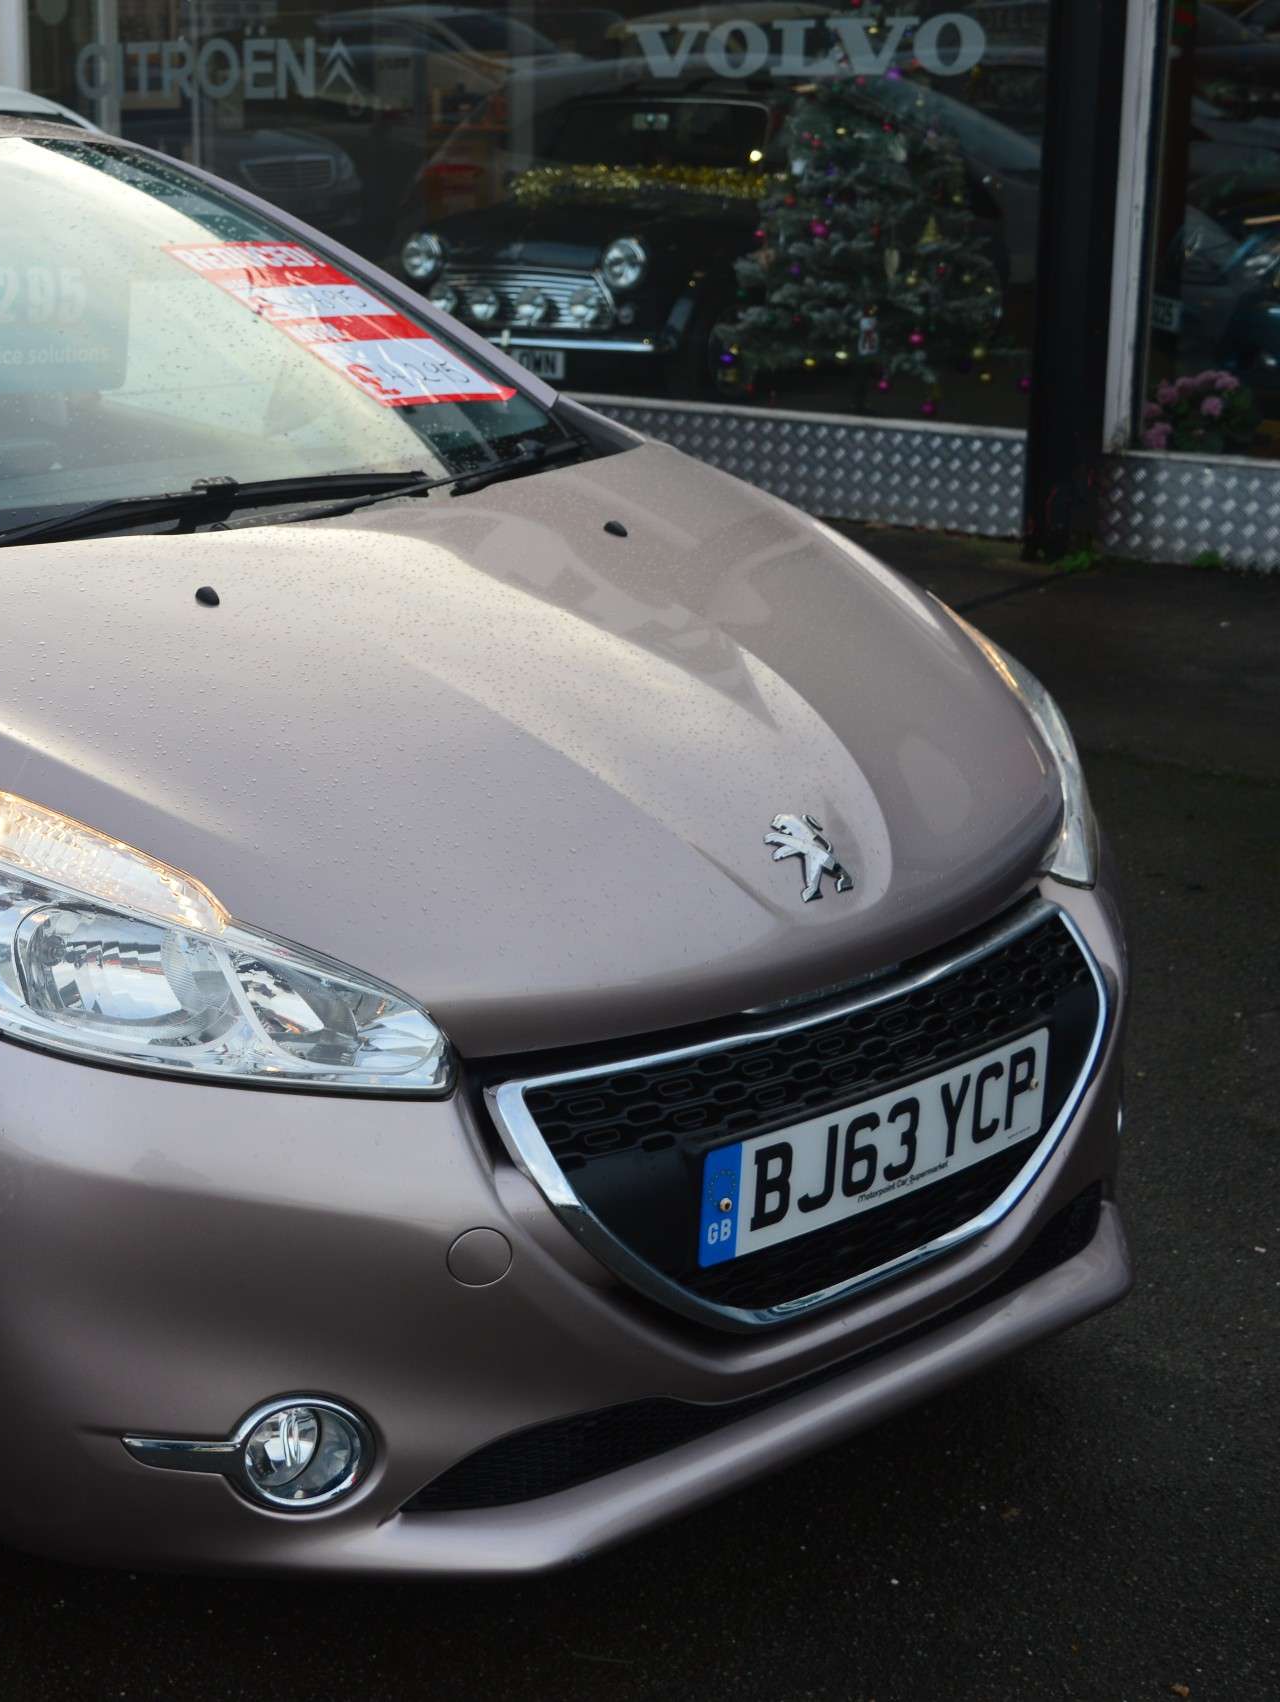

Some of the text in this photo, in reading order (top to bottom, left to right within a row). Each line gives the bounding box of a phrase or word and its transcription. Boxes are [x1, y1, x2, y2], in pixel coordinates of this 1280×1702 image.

[76, 25, 315, 100] CITROËN
[626, 13, 987, 78] VOLVO
[28, 343, 112, 365] solutions
[750, 1046, 1037, 1232] BJ63 YCP
[706, 1218, 732, 1246] GB
